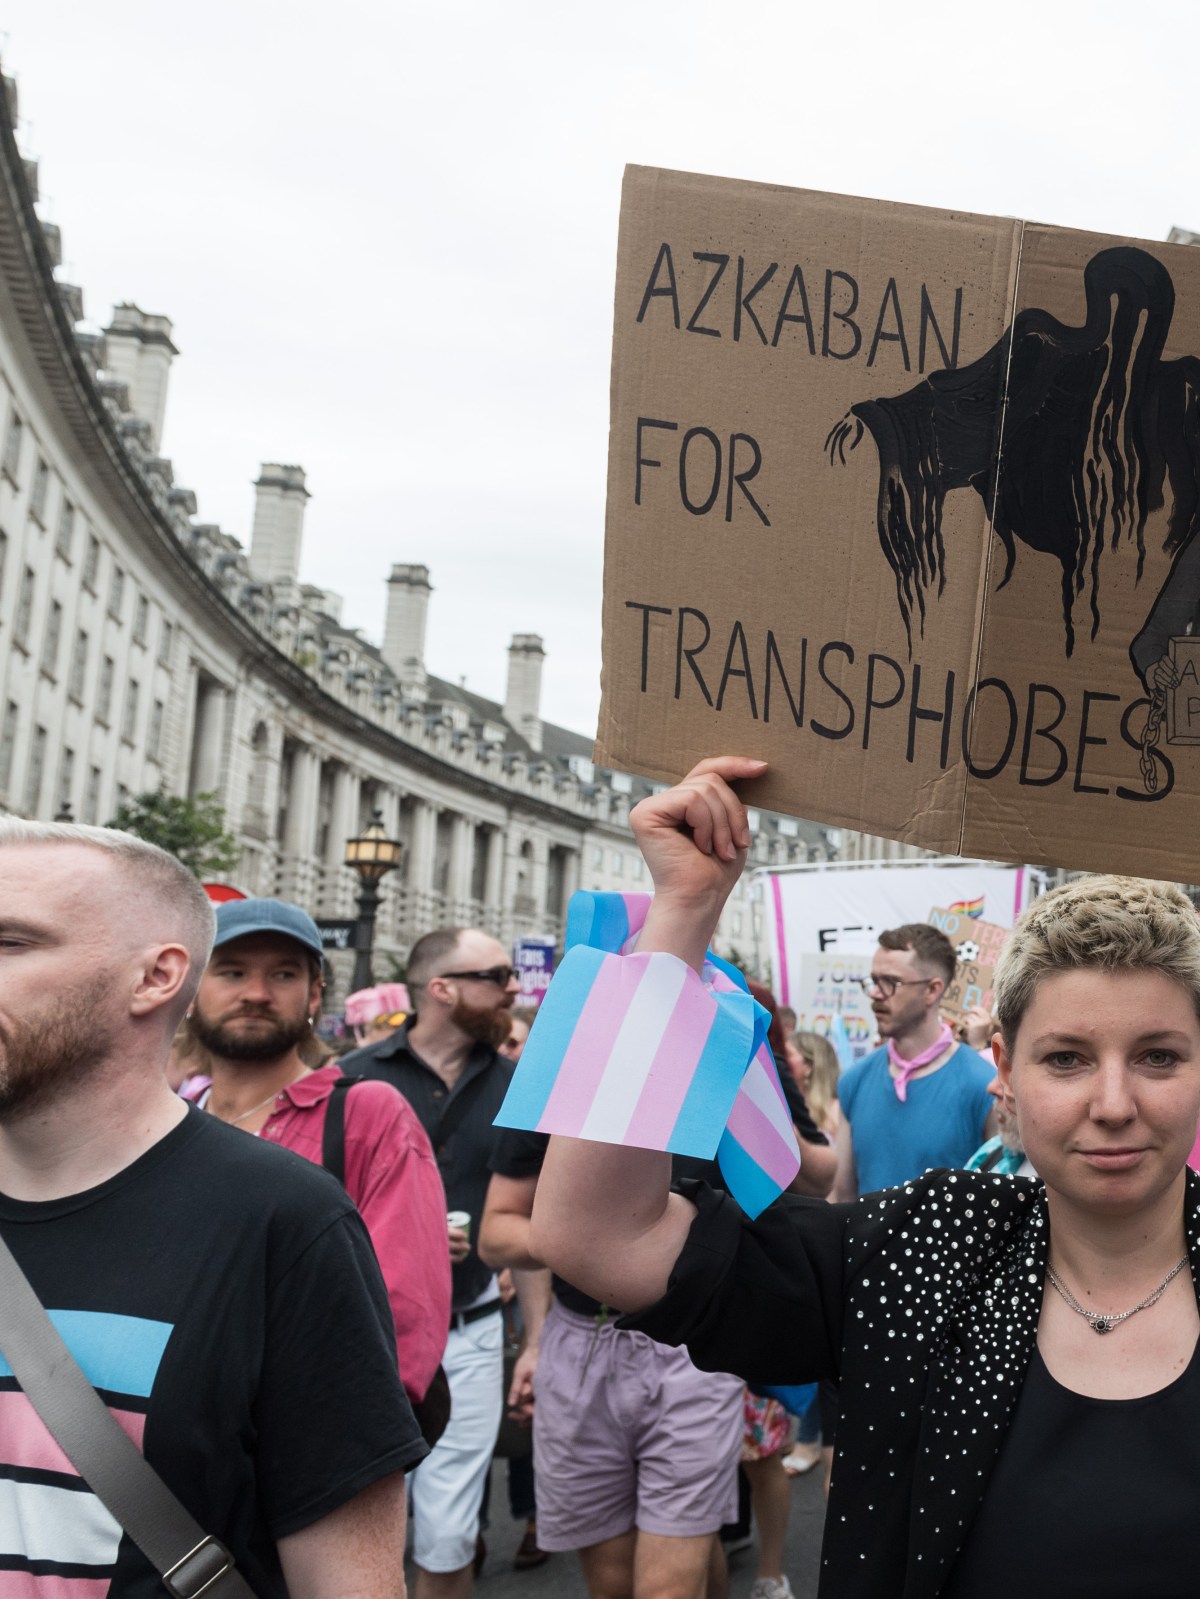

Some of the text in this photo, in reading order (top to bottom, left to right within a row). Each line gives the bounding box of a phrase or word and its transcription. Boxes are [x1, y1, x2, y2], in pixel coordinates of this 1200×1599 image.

[636, 242, 963, 374] AZKABAN
[634, 416, 771, 527] FOR
[625, 601, 1175, 802] TRANSPHOBES
[929, 910, 960, 935] NO
